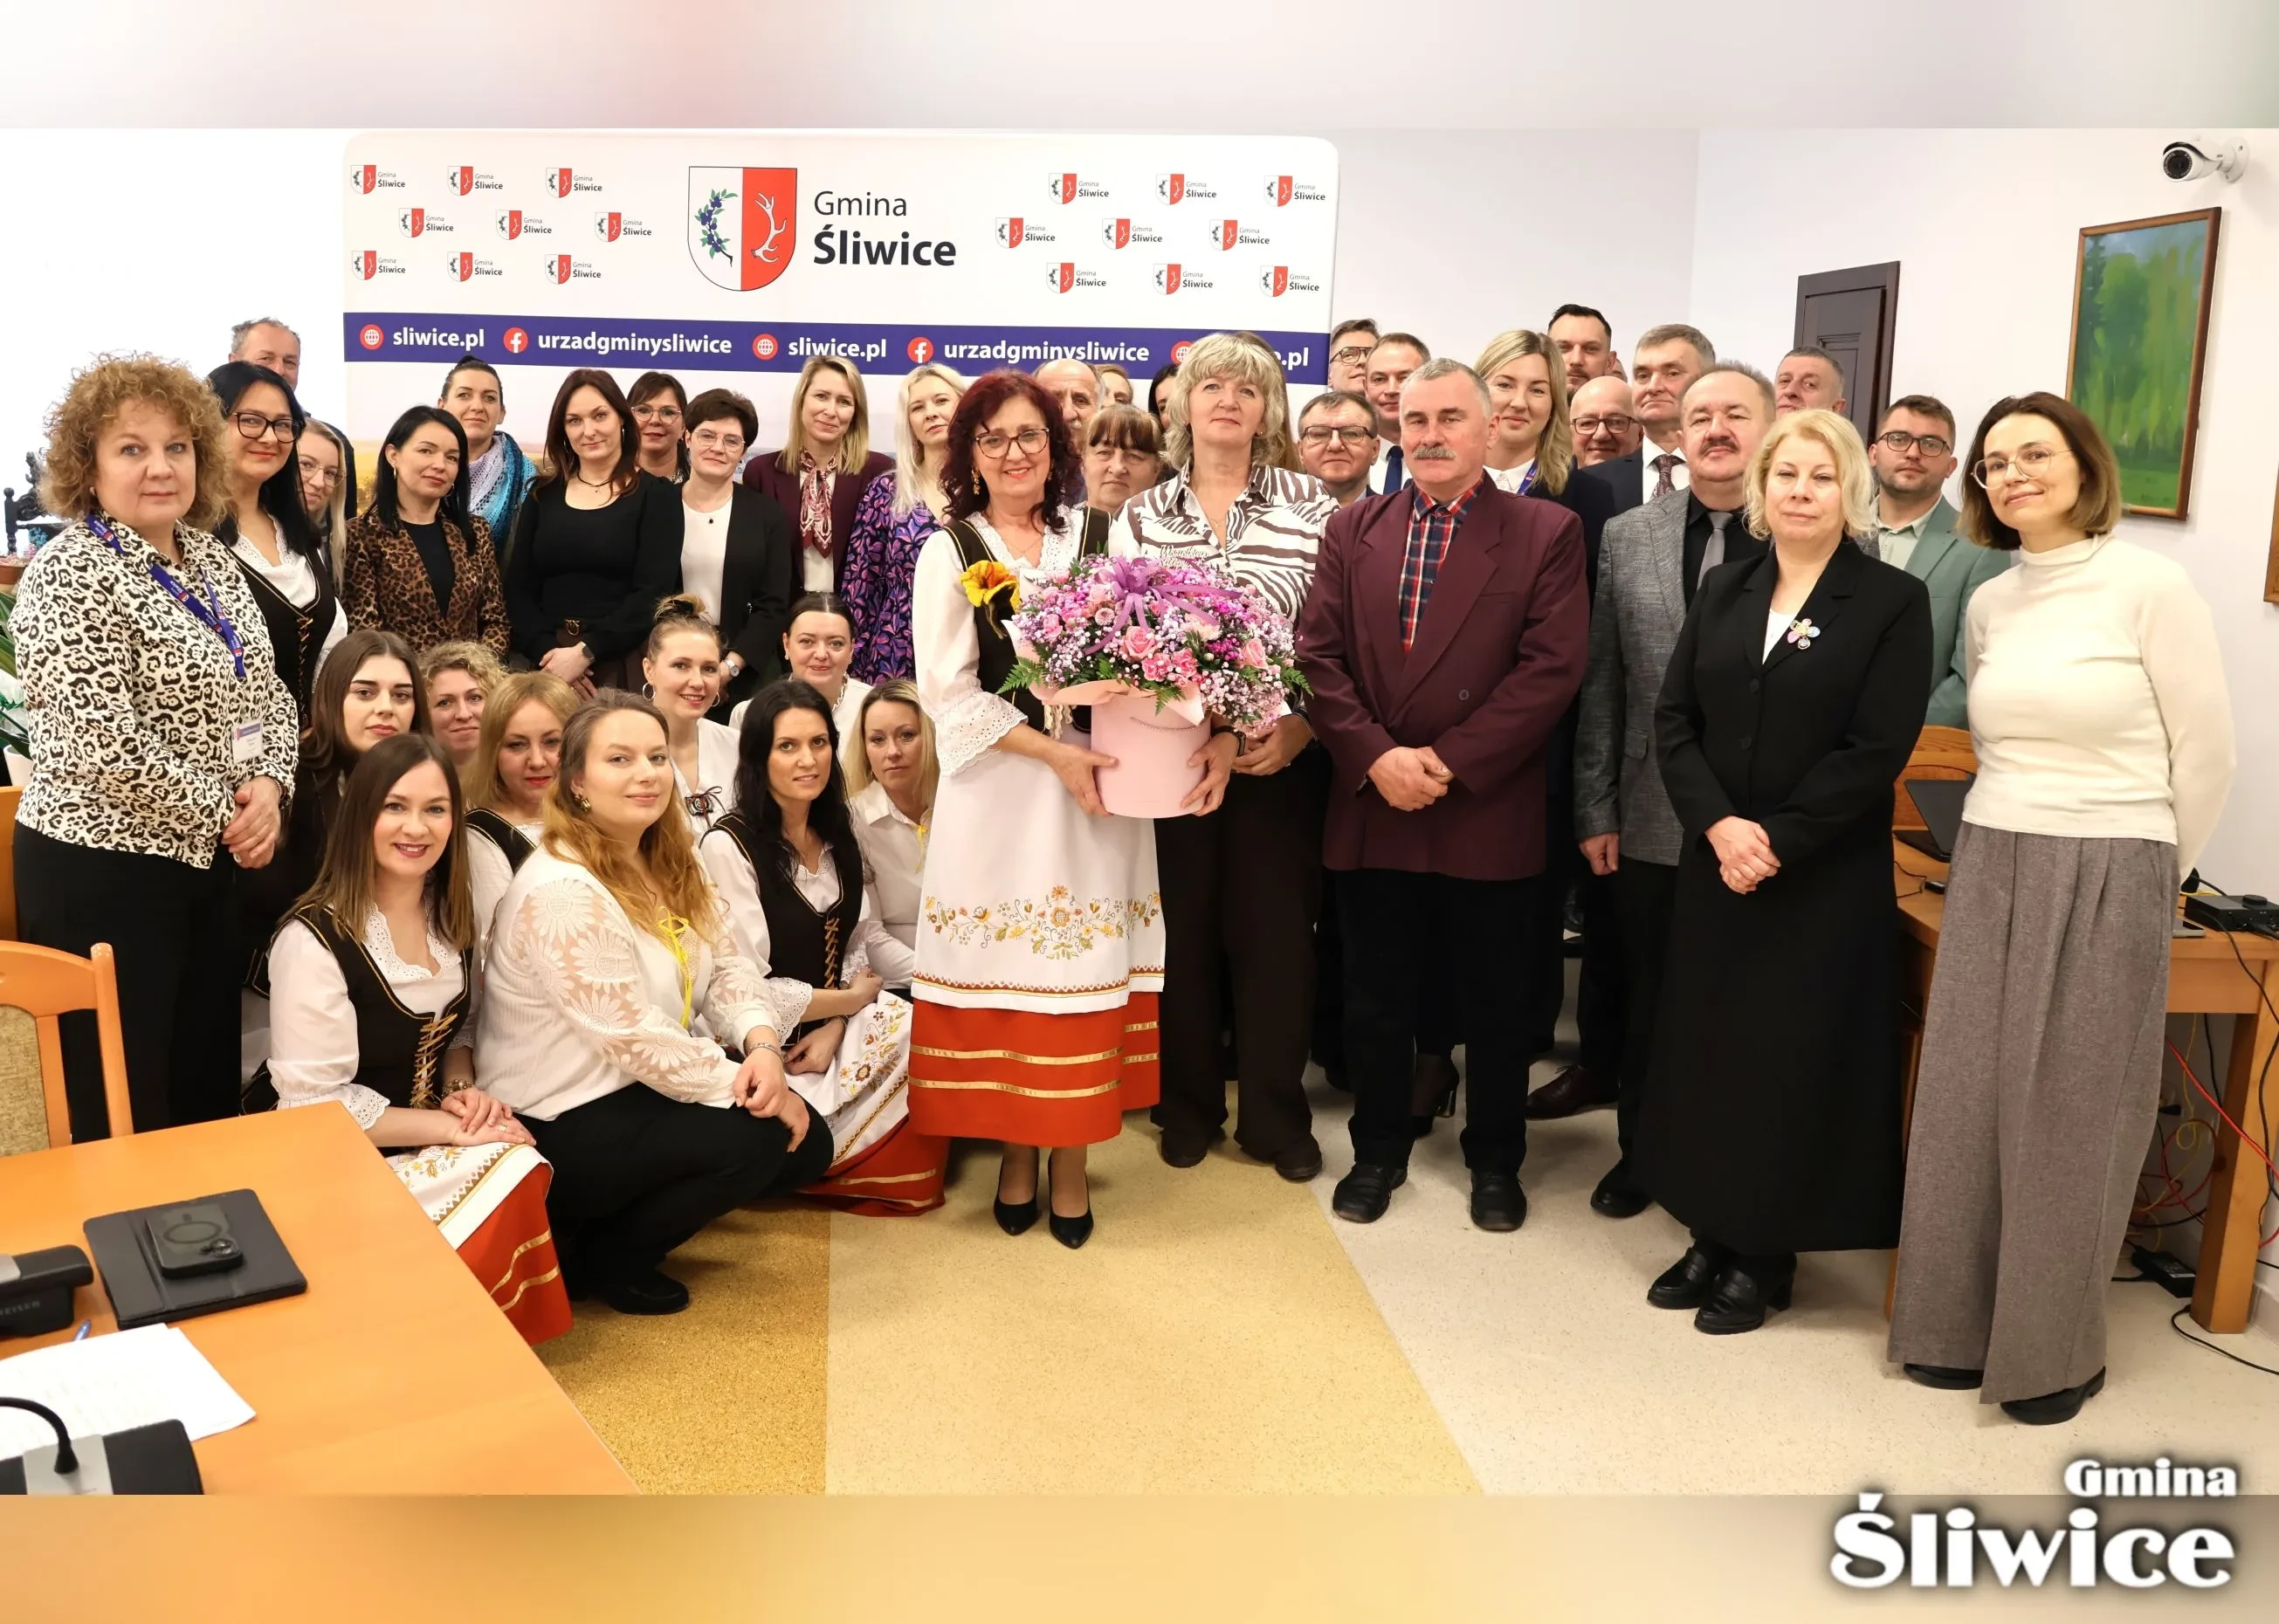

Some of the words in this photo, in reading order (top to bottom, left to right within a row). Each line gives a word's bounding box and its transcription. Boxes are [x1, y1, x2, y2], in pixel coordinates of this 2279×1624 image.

[377, 178, 406, 189] Śliwice
[474, 180, 504, 190] Śliwice
[573, 182, 602, 192] Śliwice
[1078, 187, 1110, 197] Śliwice
[1185, 188, 1217, 198] Śliwice
[1293, 189, 1326, 201] Śliwice
[814, 190, 907, 217] Gmina
[425, 222, 454, 232] Śliwice
[523, 224, 553, 234] Śliwice
[623, 225, 652, 237] Śliwice
[1024, 231, 1056, 242] Śliwice
[1131, 232, 1163, 243] Śliwice
[1238, 234, 1270, 244] Śliwice
[813, 224, 957, 266] Śliwice
[377, 264, 406, 274] Śliwice
[474, 265, 503, 276] Śliwice
[572, 268, 602, 279] Śliwice
[1075, 277, 1107, 287] Śliwice
[1181, 278, 1214, 289] Śliwice
[1289, 280, 1320, 292] Śliwice
[393, 327, 485, 351] sliwice.pl
[538, 331, 733, 357] urzadgminysliwice
[788, 337, 886, 361] sliwice.pl
[944, 340, 1150, 363] urzadgminysliwice
